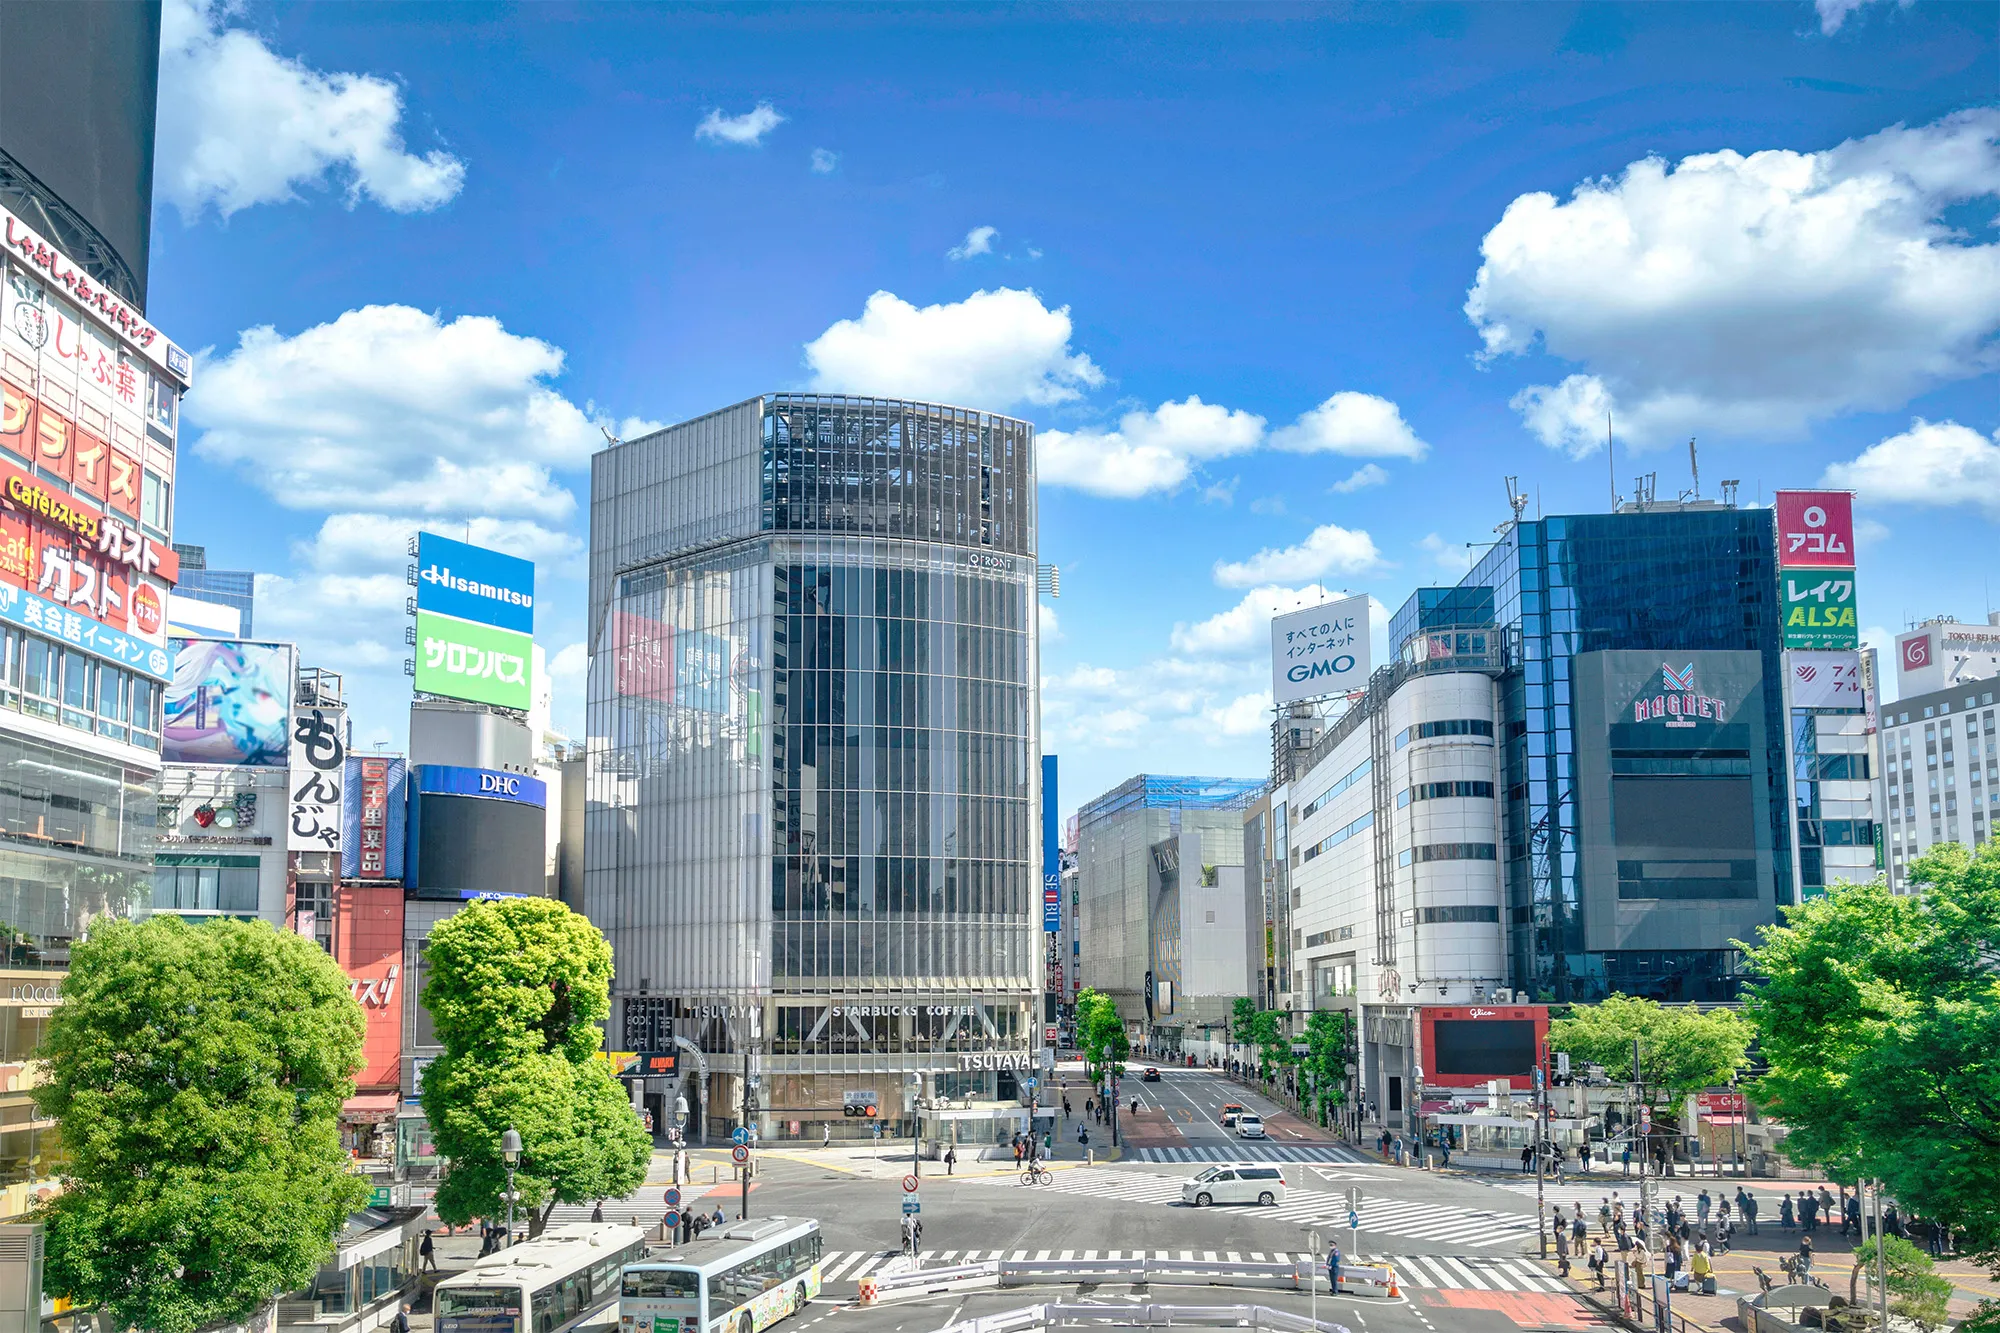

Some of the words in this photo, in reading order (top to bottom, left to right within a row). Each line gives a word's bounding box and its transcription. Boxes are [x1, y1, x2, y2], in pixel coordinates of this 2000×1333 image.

[6, 216, 157, 348] しゃぶしゃぶバイキング
[55, 314, 136, 404] しゃぶ葉
[100, 516, 160, 573] ガスト
[1787, 533, 1846, 553] アコム
[38, 545, 122, 618] ガスト
[421, 565, 532, 608] Hisamitsu
[1787, 580, 1852, 602] レイク
[136, 602, 158, 623] ガスト
[1787, 607, 1856, 628] ALSA
[24, 596, 144, 663] 英会話イーオン
[1286, 617, 1354, 643] すべての人に
[1948, 632, 1974, 641] TOKYU
[1977, 633, 1988, 642] REI
[1286, 634, 1354, 659] インターネット
[151, 652, 166, 671] 6F
[424, 637, 525, 686] サロンパス
[1287, 655, 1355, 682] GMO
[1635, 694, 1725, 722] MAGNET
[292, 710, 345, 848] もんじゃ
[480, 774, 520, 796] DHC
[361, 762, 386, 871] 三千里薬品
[832, 1006, 917, 1017] STARBUCKS
[926, 1006, 975, 1017] COFFEE
[1470, 1008, 1496, 1019] Glico
[961, 1054, 1030, 1070] TSUTAYA
